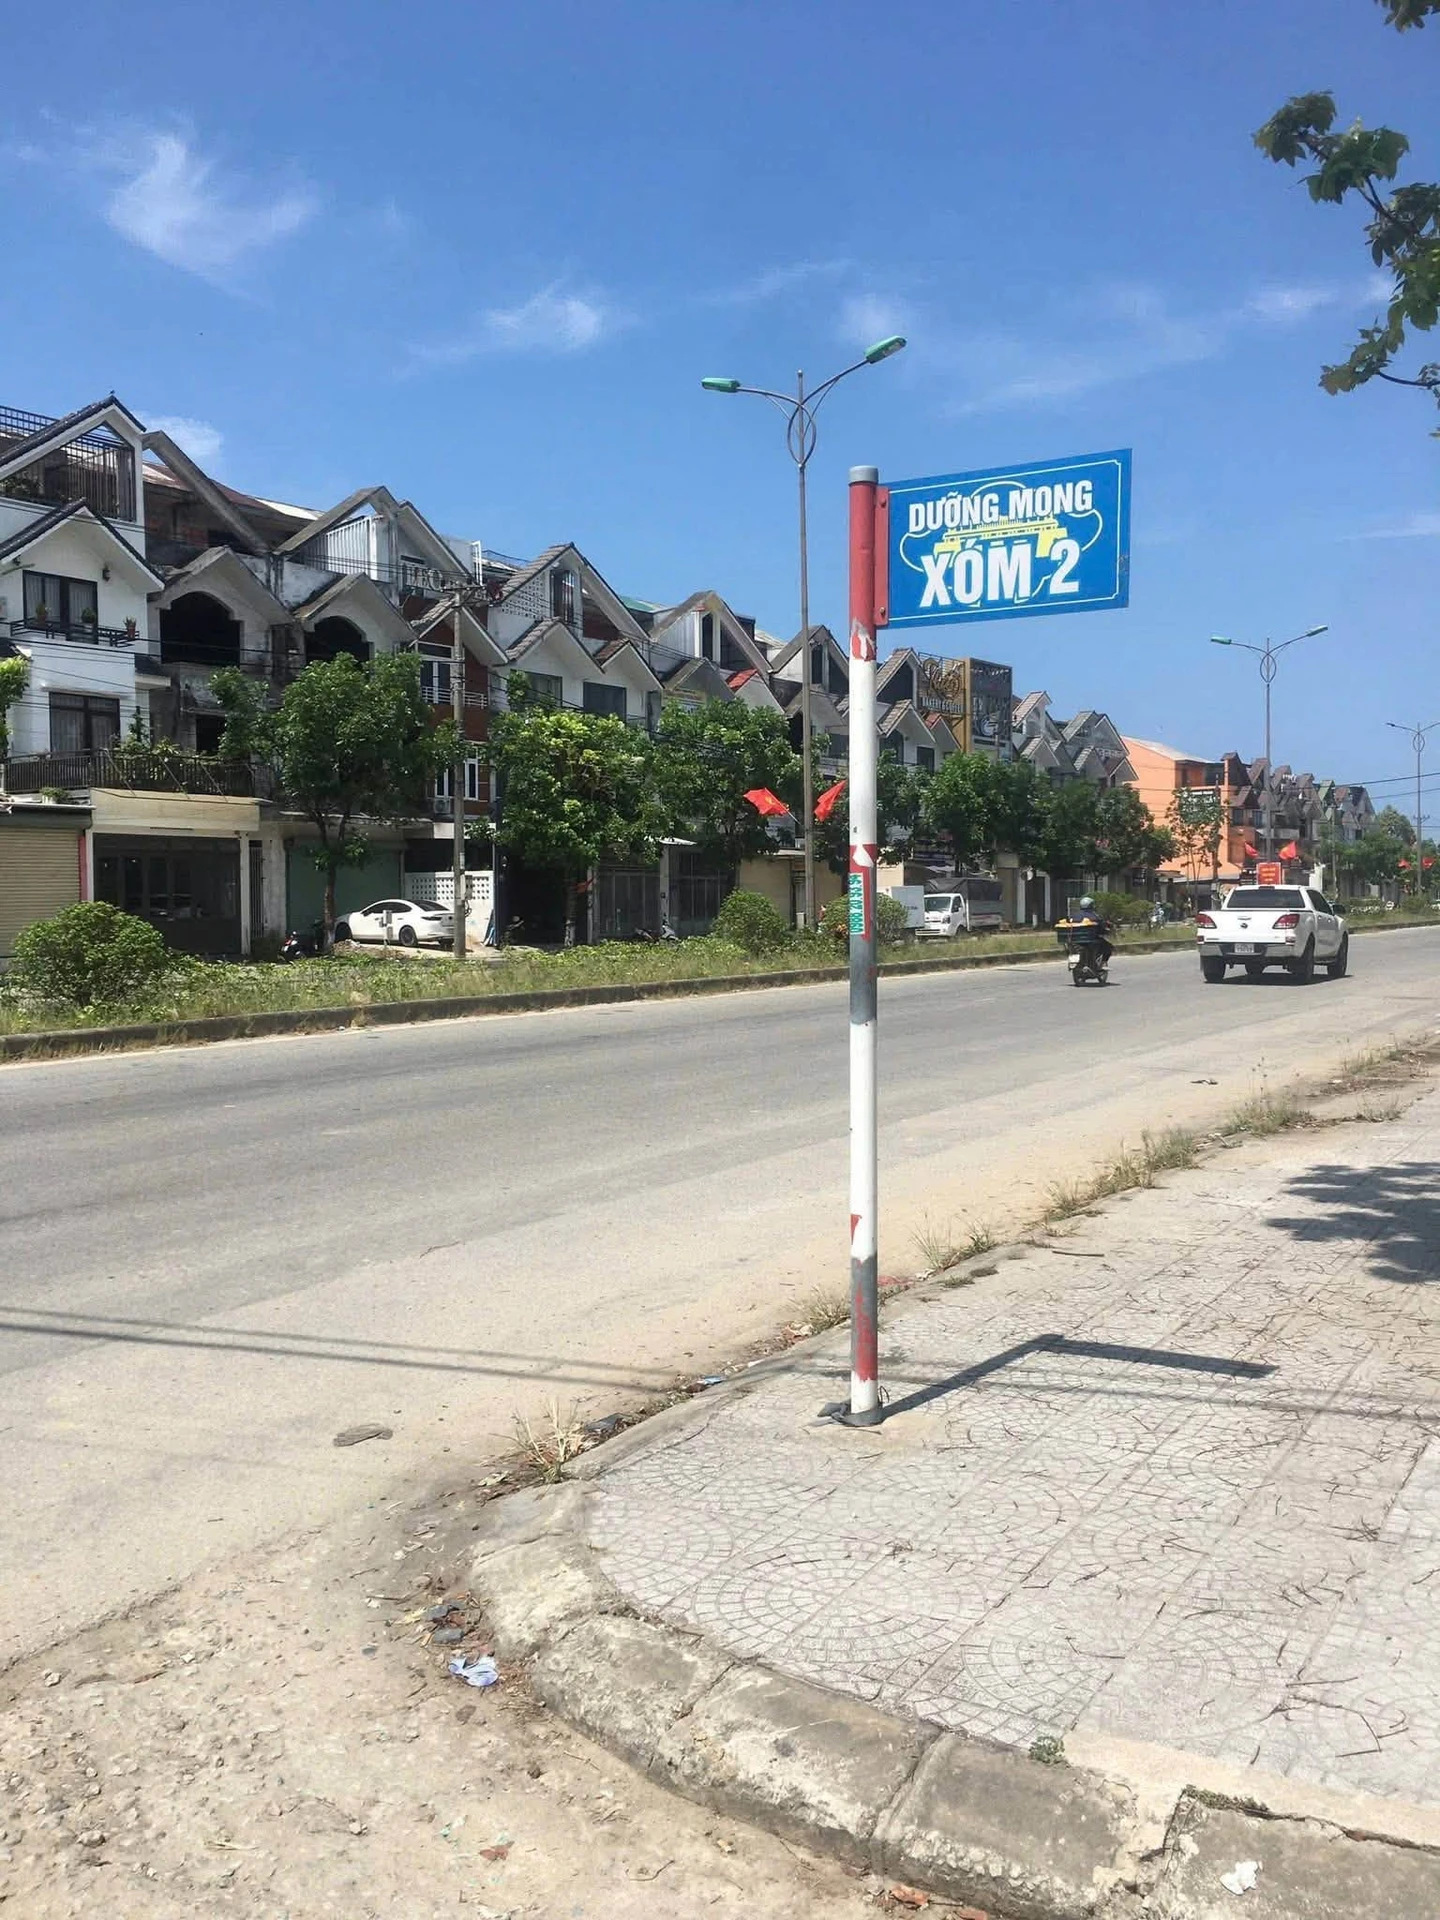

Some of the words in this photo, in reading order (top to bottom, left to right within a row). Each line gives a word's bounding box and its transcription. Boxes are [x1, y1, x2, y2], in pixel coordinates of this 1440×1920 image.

[908, 490, 999, 533] DƯỠNG
[919, 538, 1032, 608] XÓM
[1049, 539, 1080, 594] 2
